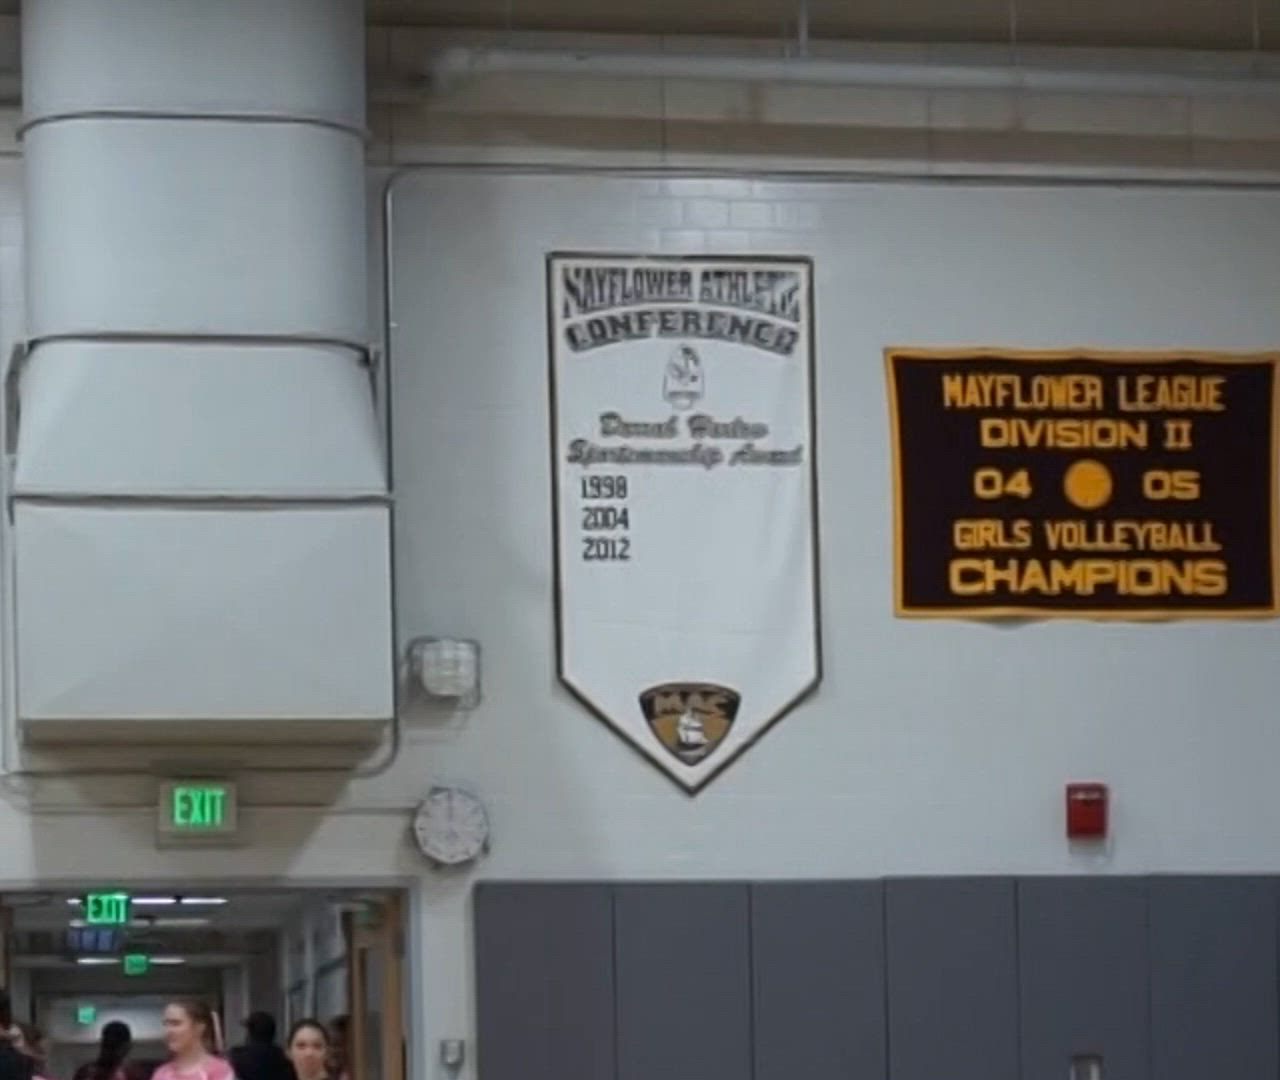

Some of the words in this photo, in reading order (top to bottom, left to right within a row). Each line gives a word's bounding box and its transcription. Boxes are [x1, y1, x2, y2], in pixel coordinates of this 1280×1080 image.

[563, 266, 692, 318] MAYFLOWER
[566, 309, 801, 356] CONFERENCE
[943, 374, 1103, 411] MAYFLOWER
[1118, 376, 1227, 412] LEAGUE
[980, 418, 1148, 449] DIVISION
[1164, 420, 1193, 450] II
[581, 475, 629, 499] 1998
[973, 468, 1032, 499] 04
[1143, 470, 1201, 500] 05
[582, 506, 630, 531] 2004
[582, 537, 631, 561] 2012
[953, 519, 1032, 550] GIRLS
[1046, 521, 1222, 551] VOLLEYBALL
[949, 559, 1228, 596] CHAMPIONS
[173, 786, 226, 827] EXIT
[87, 893, 128, 923] EXIT
